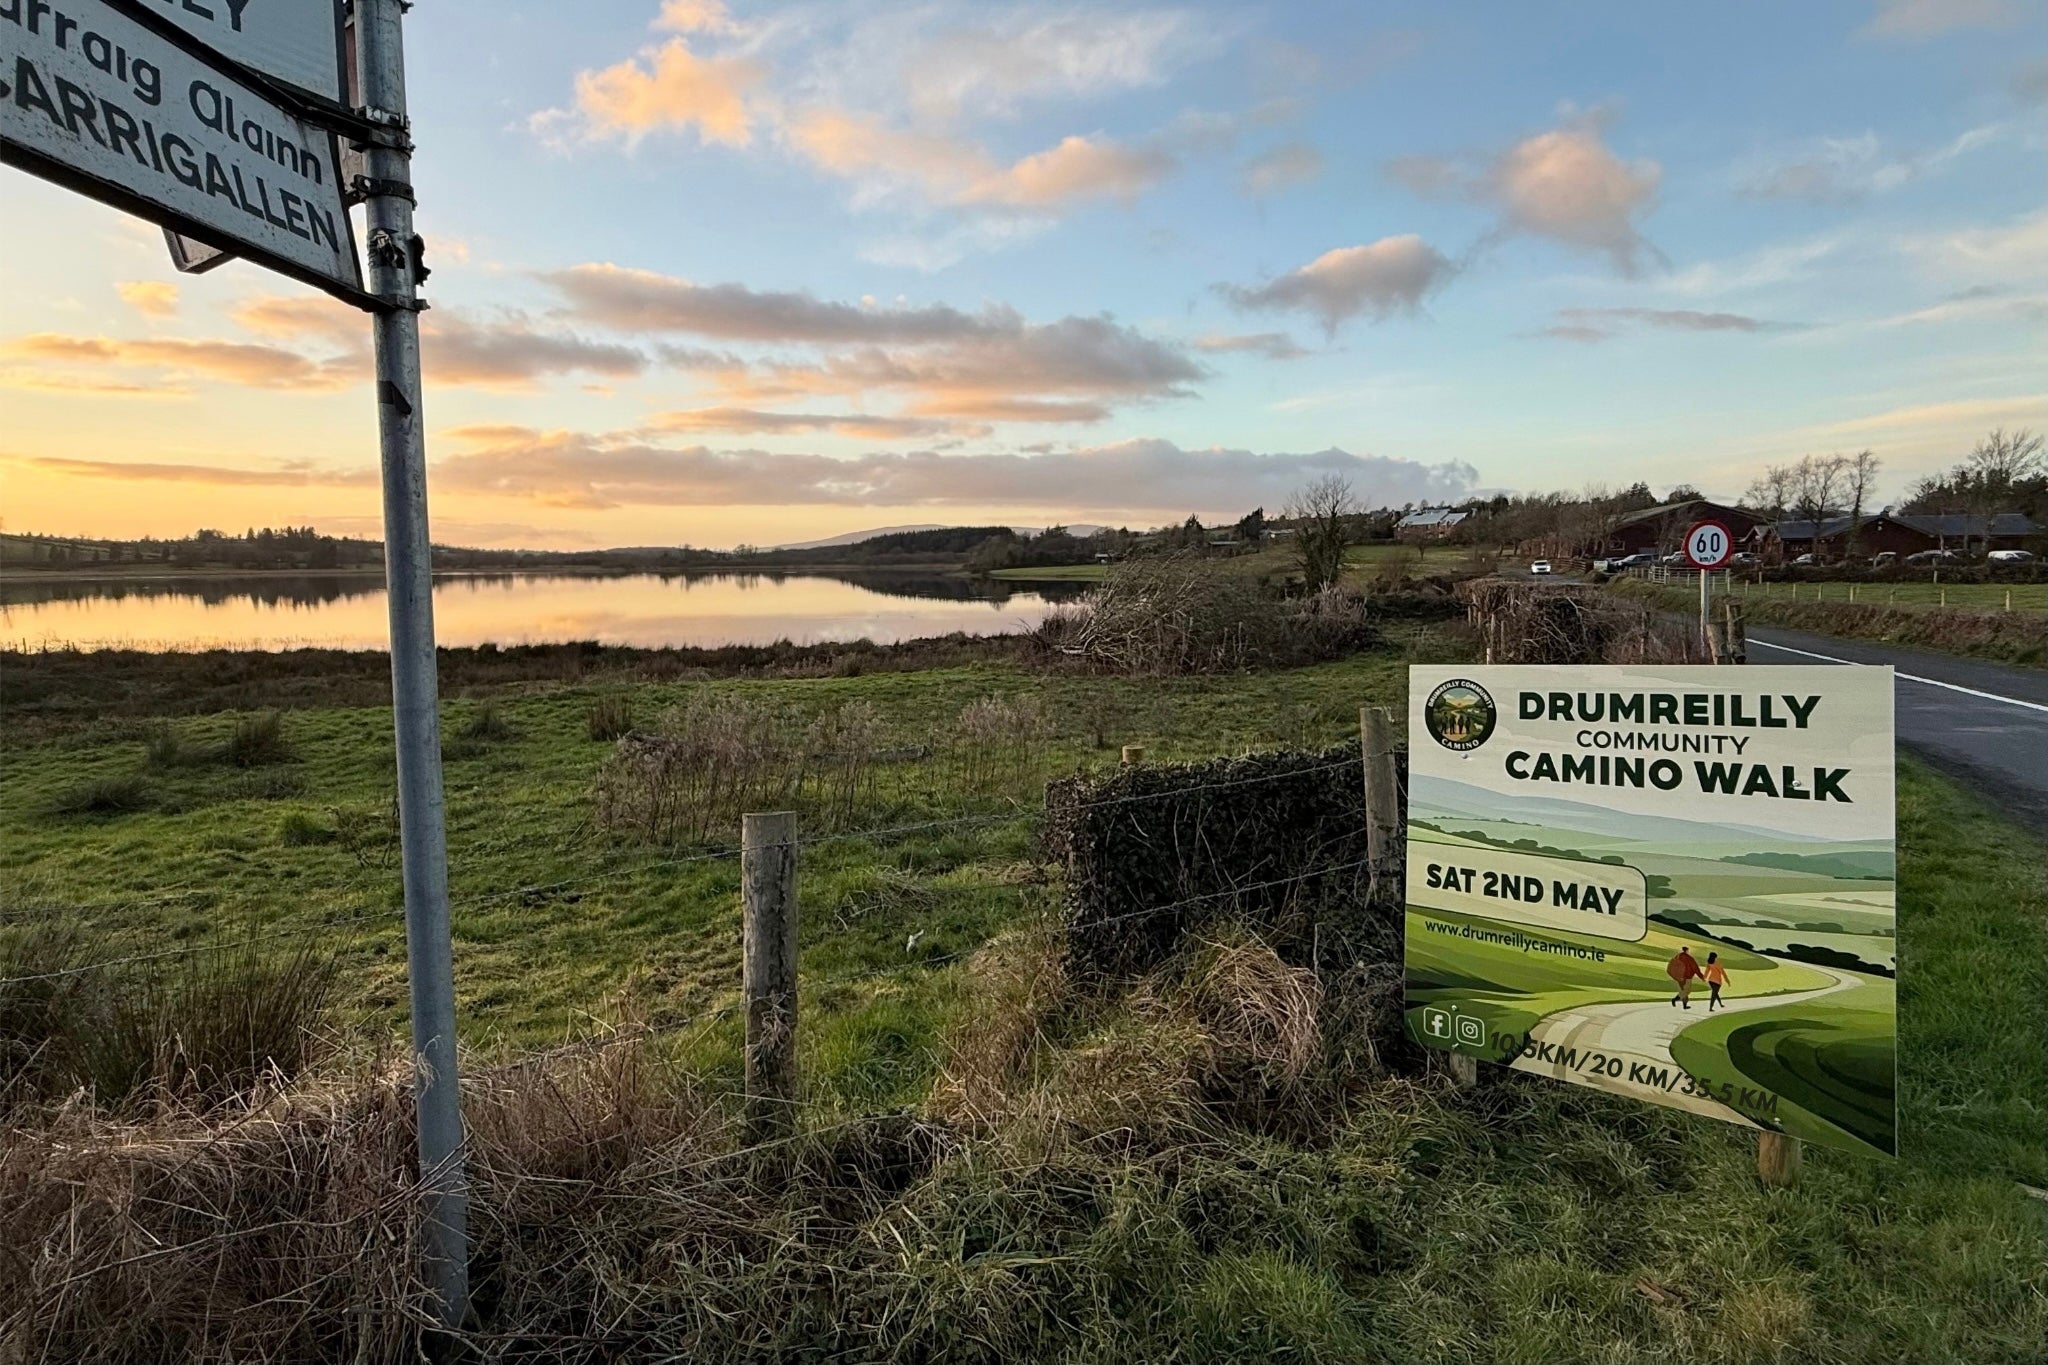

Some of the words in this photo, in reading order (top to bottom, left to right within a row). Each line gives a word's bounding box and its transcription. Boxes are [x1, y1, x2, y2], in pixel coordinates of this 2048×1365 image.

[0, 55, 341, 254] ARRIGALLEN
[1696, 532, 1720, 554] 60
[1699, 554, 1717, 562] km/h
[1427, 680, 1460, 708] DRUMREILLY
[1460, 680, 1494, 709] COMMUNITY
[1518, 691, 1822, 729] DRUMREILLY
[1441, 738, 1480, 750] CAMINO
[1576, 729, 1751, 756] COMMUNITY
[1505, 750, 1683, 791] CAMINO
[1693, 760, 1854, 804] WALK
[1426, 863, 1477, 894] SAT
[1482, 871, 1544, 904] 2ND
[1552, 880, 1625, 916] MAY
[1425, 920, 1605, 963] www.drumreillycamino.ie
[1738, 1086, 1779, 1114] KM
